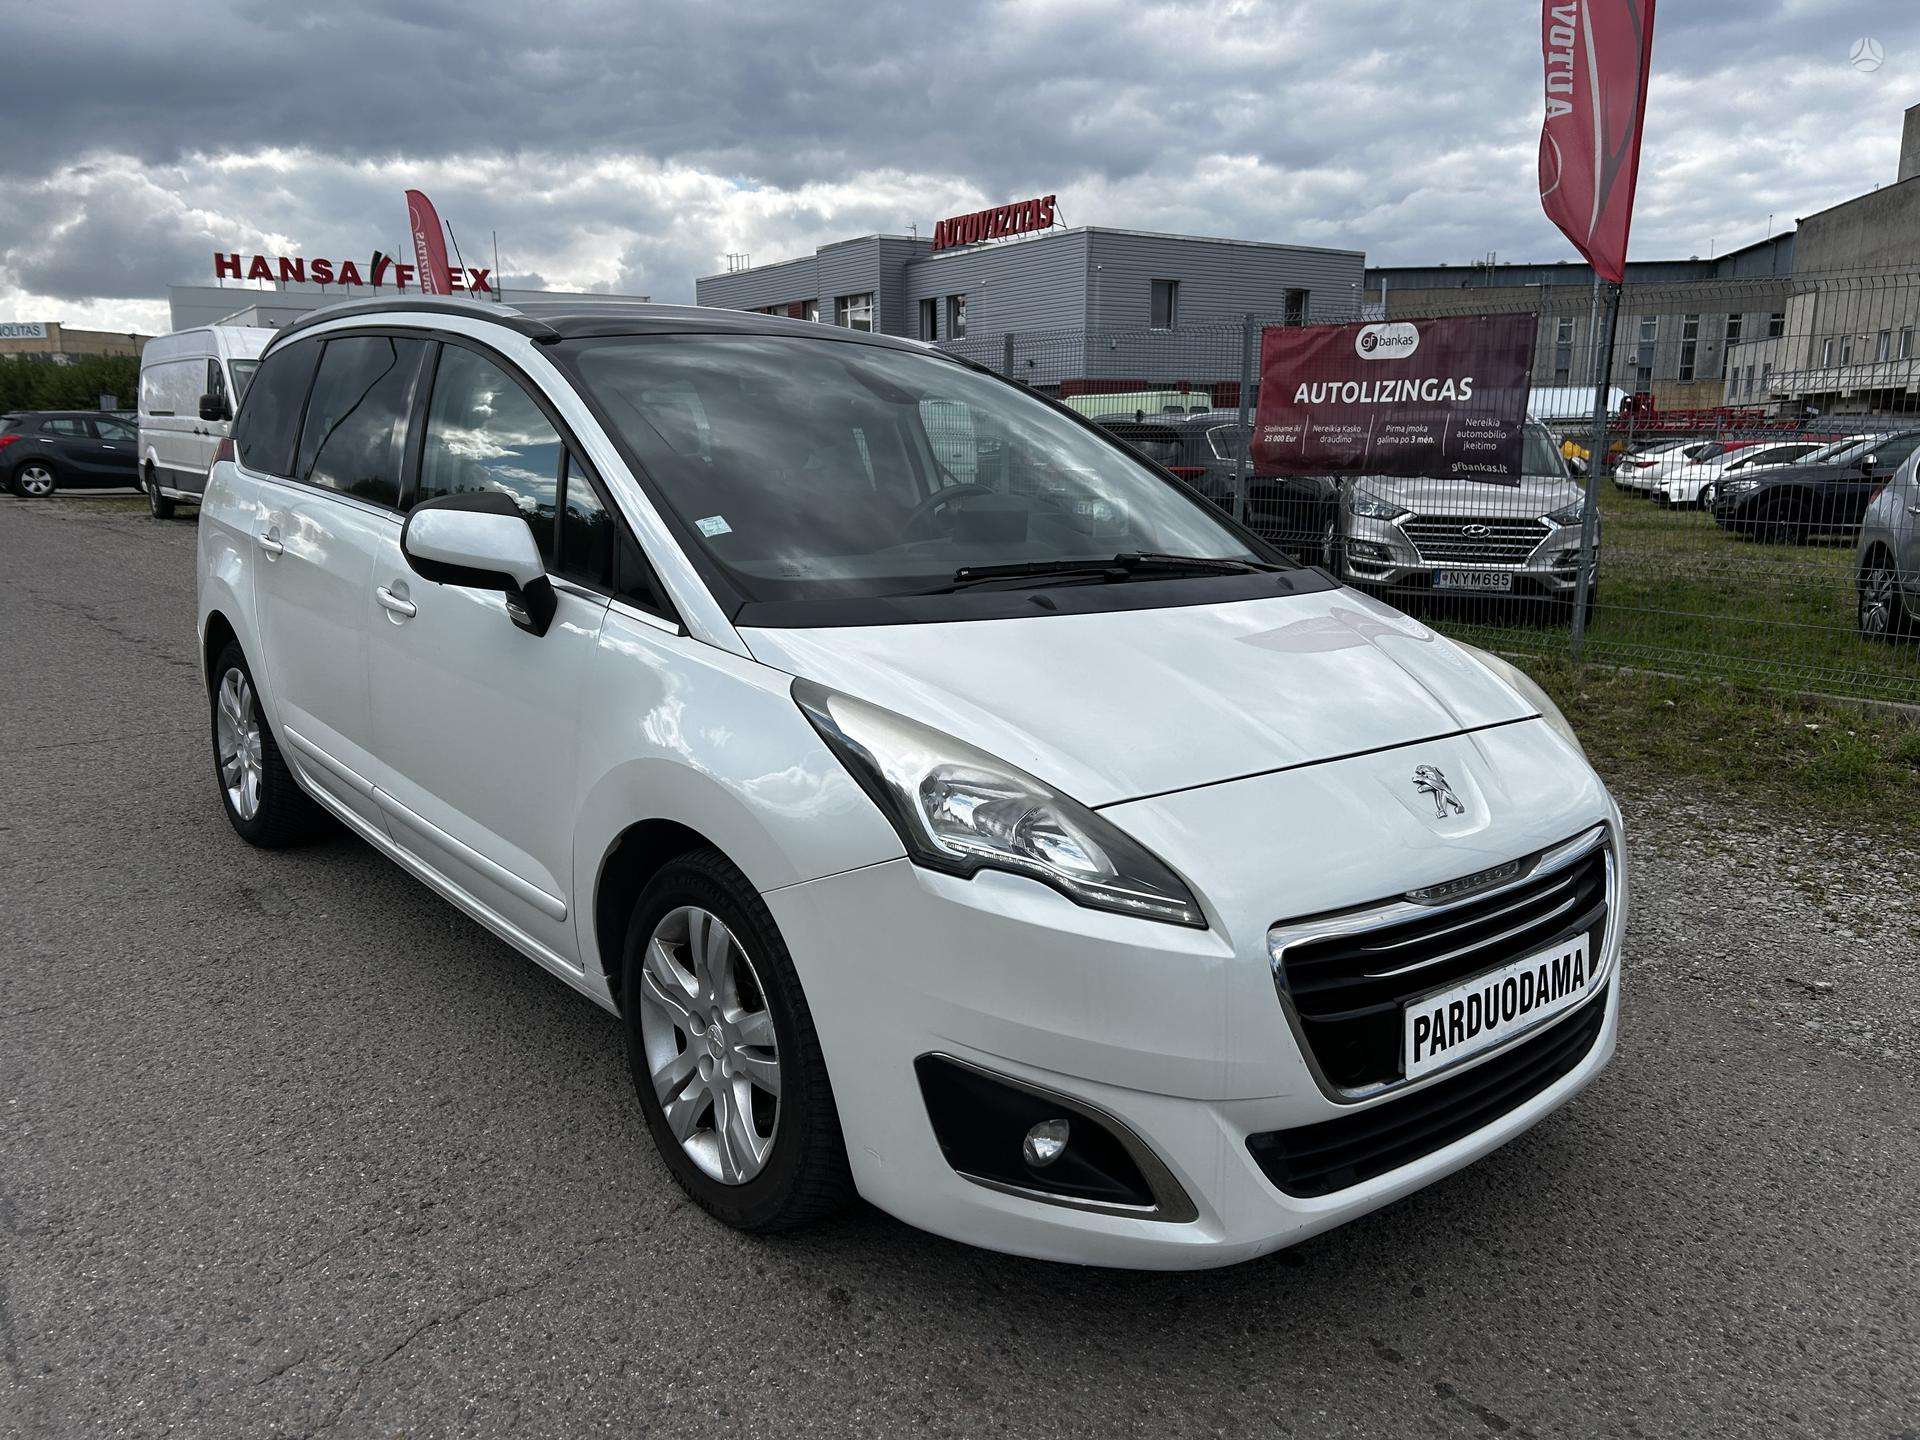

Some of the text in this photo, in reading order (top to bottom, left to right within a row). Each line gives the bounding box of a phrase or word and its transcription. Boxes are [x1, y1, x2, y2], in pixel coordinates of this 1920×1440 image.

[930, 194, 1056, 251] AUTOVIZITAS
[214, 252, 493, 293] HANSA FEX
[0, 325, 41, 337] OLITAS
[1293, 377, 1474, 404] AUTOLIZINGAS
[1312, 424, 1362, 433] Nereikia Kasko
[1385, 424, 1405, 433] Pirma
[1465, 418, 1500, 428] Nereikia
[1264, 435, 1297, 443] 25 000 Eur
[1319, 435, 1352, 444] draudimo
[1456, 430, 1507, 439] automobilio
[1376, 435, 1399, 446] galima
[1399, 437, 1410, 446] po
[1410, 435, 1416, 444] 3
[1451, 461, 1509, 475] gfbankas.lt
[1413, 948, 1585, 1064] PARDUODAMA
